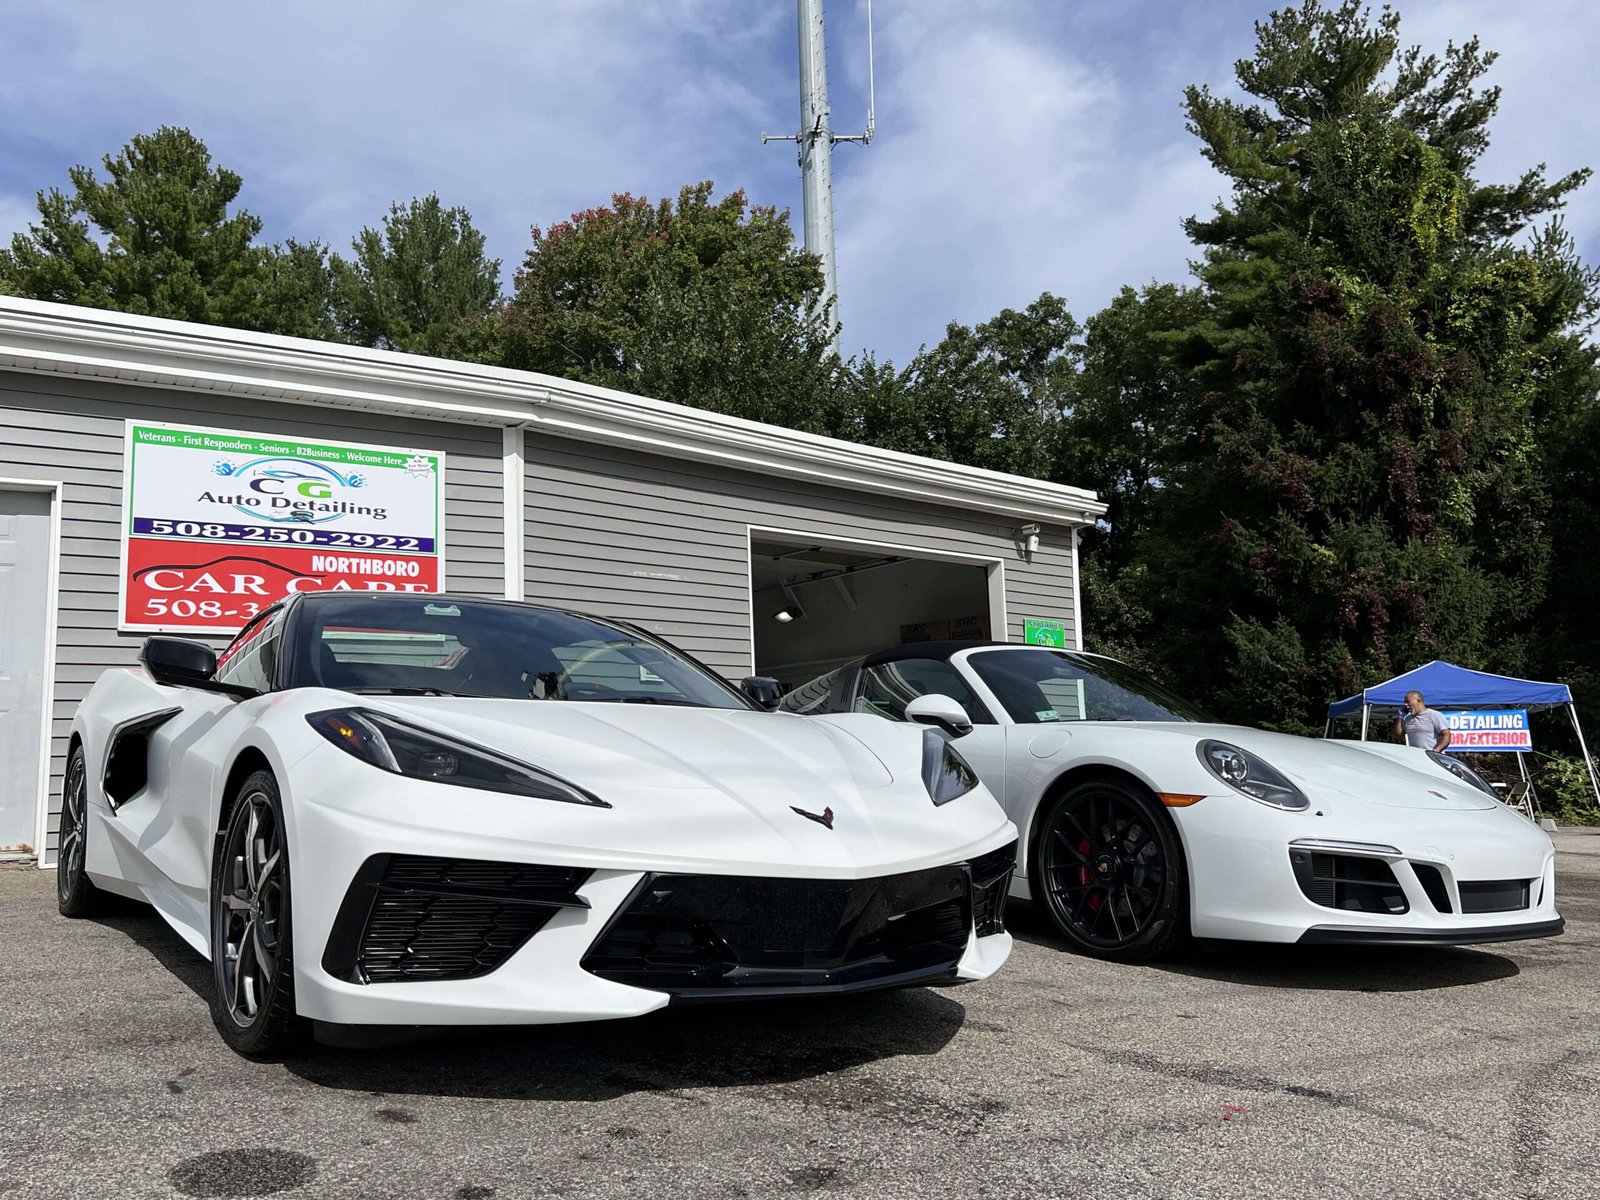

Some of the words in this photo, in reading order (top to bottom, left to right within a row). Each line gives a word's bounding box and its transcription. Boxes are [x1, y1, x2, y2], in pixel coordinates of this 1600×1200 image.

[138, 430, 176, 443] Veterans
[183, 435, 202, 446] First
[204, 437, 253, 451] Responders
[259, 443, 290, 454] Seniors
[296, 446, 340, 459] B2Business
[346, 452, 383, 464] Welcome
[384, 456, 403, 466] Here
[249, 478, 285, 495] C
[297, 482, 332, 499] G
[197, 491, 261, 506] Auto
[271, 497, 388, 520] Detailing
[149, 520, 420, 551] 508-250-2922
[312, 555, 420, 577] NORTHBORO
[144, 570, 270, 595] CAR
[1450, 714, 1523, 729] DETAILING
